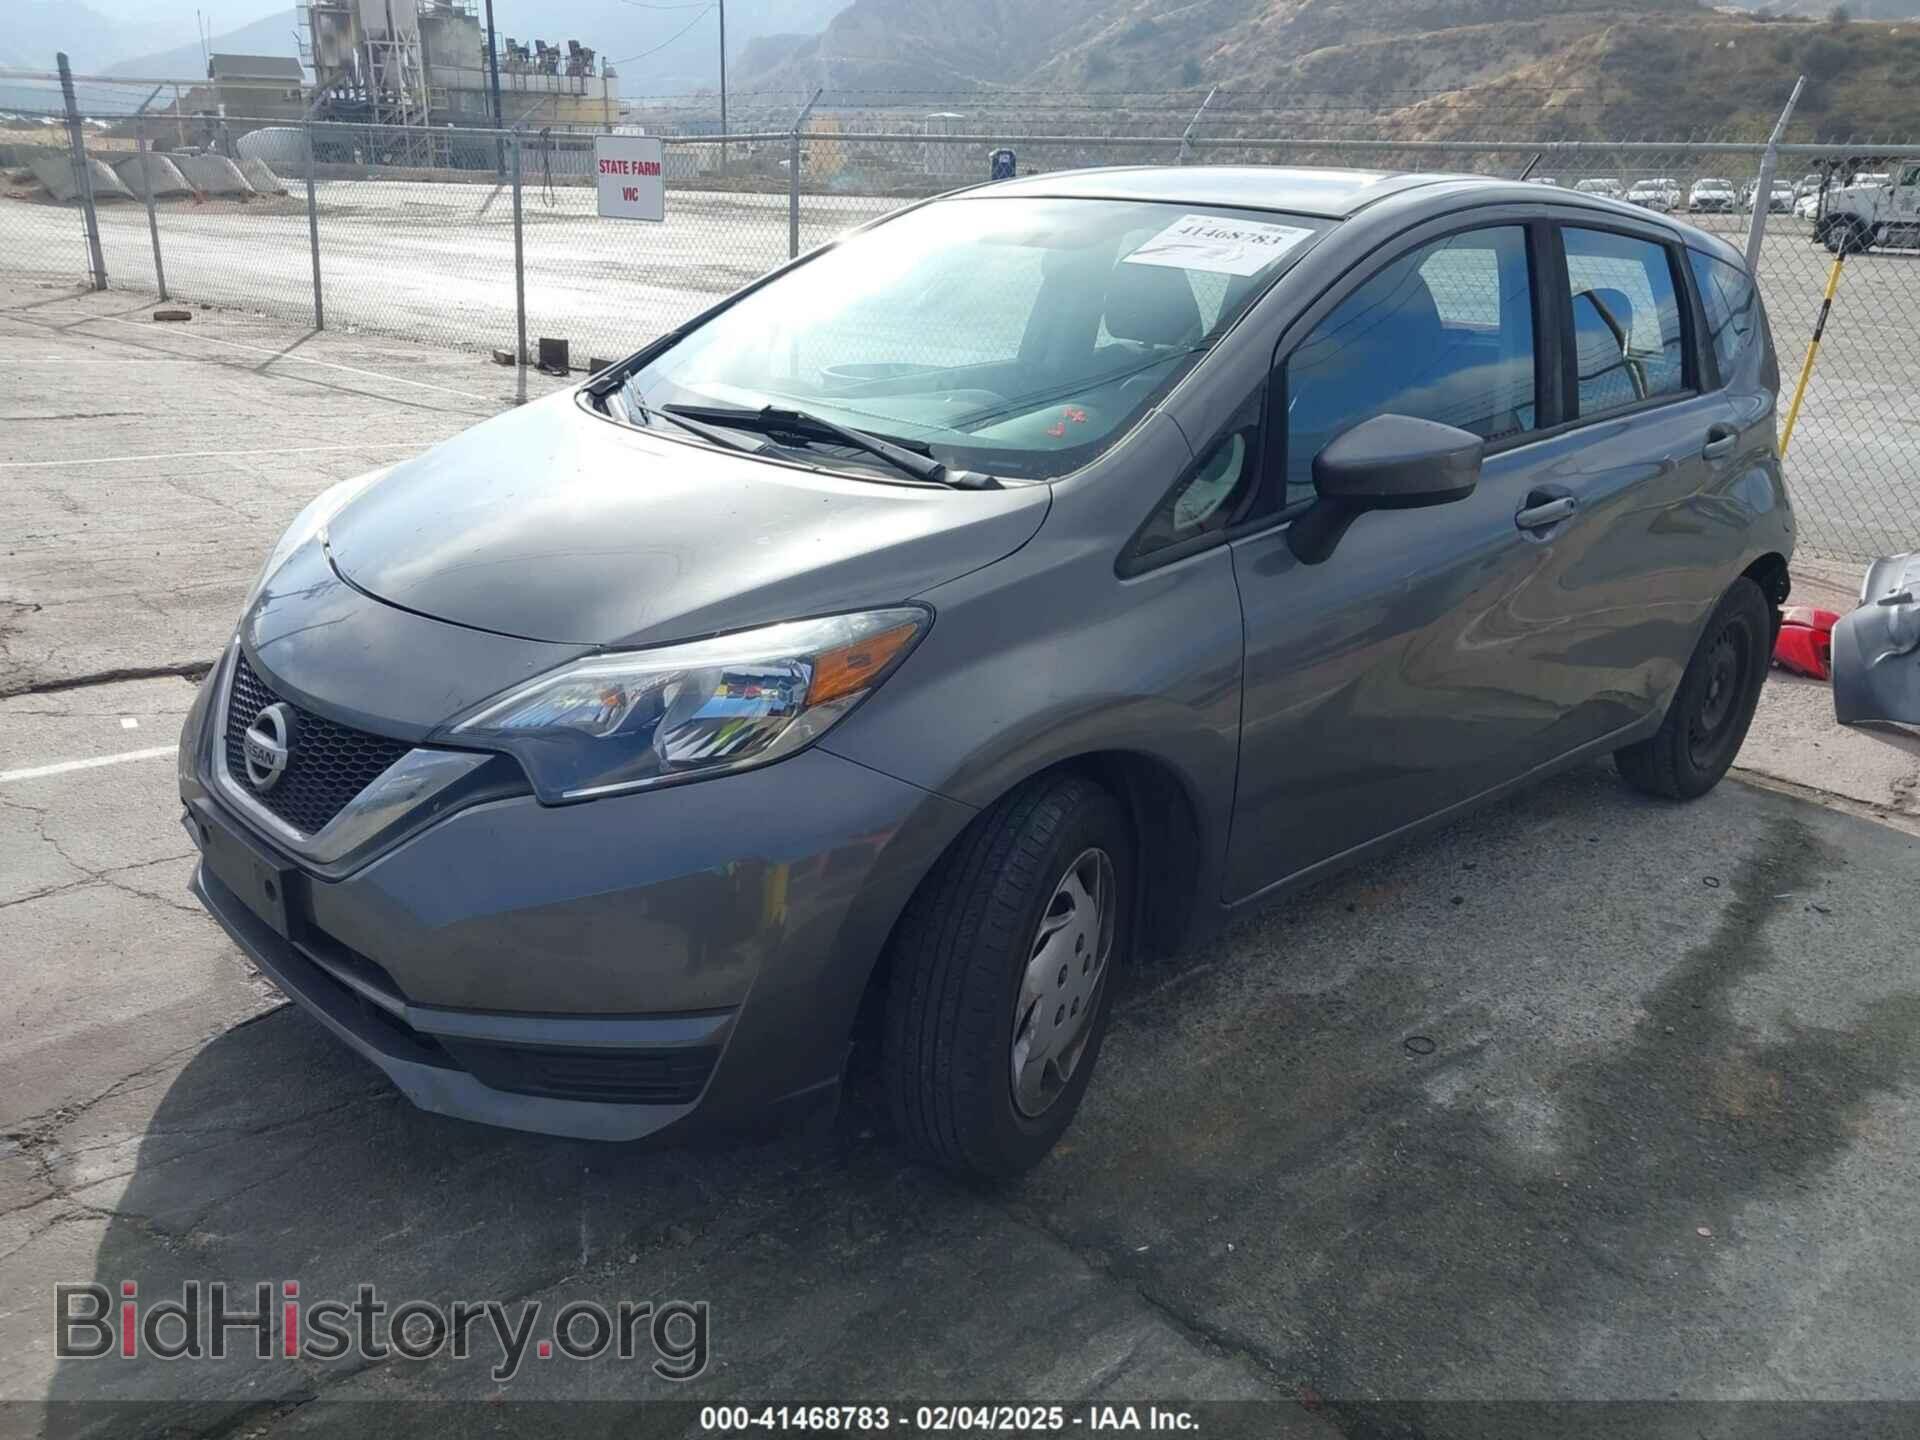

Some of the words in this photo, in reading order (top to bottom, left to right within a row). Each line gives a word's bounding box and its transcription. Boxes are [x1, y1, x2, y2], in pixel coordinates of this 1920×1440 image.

[599, 160, 630, 175] STATE
[632, 161, 661, 176] FARM
[622, 187, 639, 202] VIC
